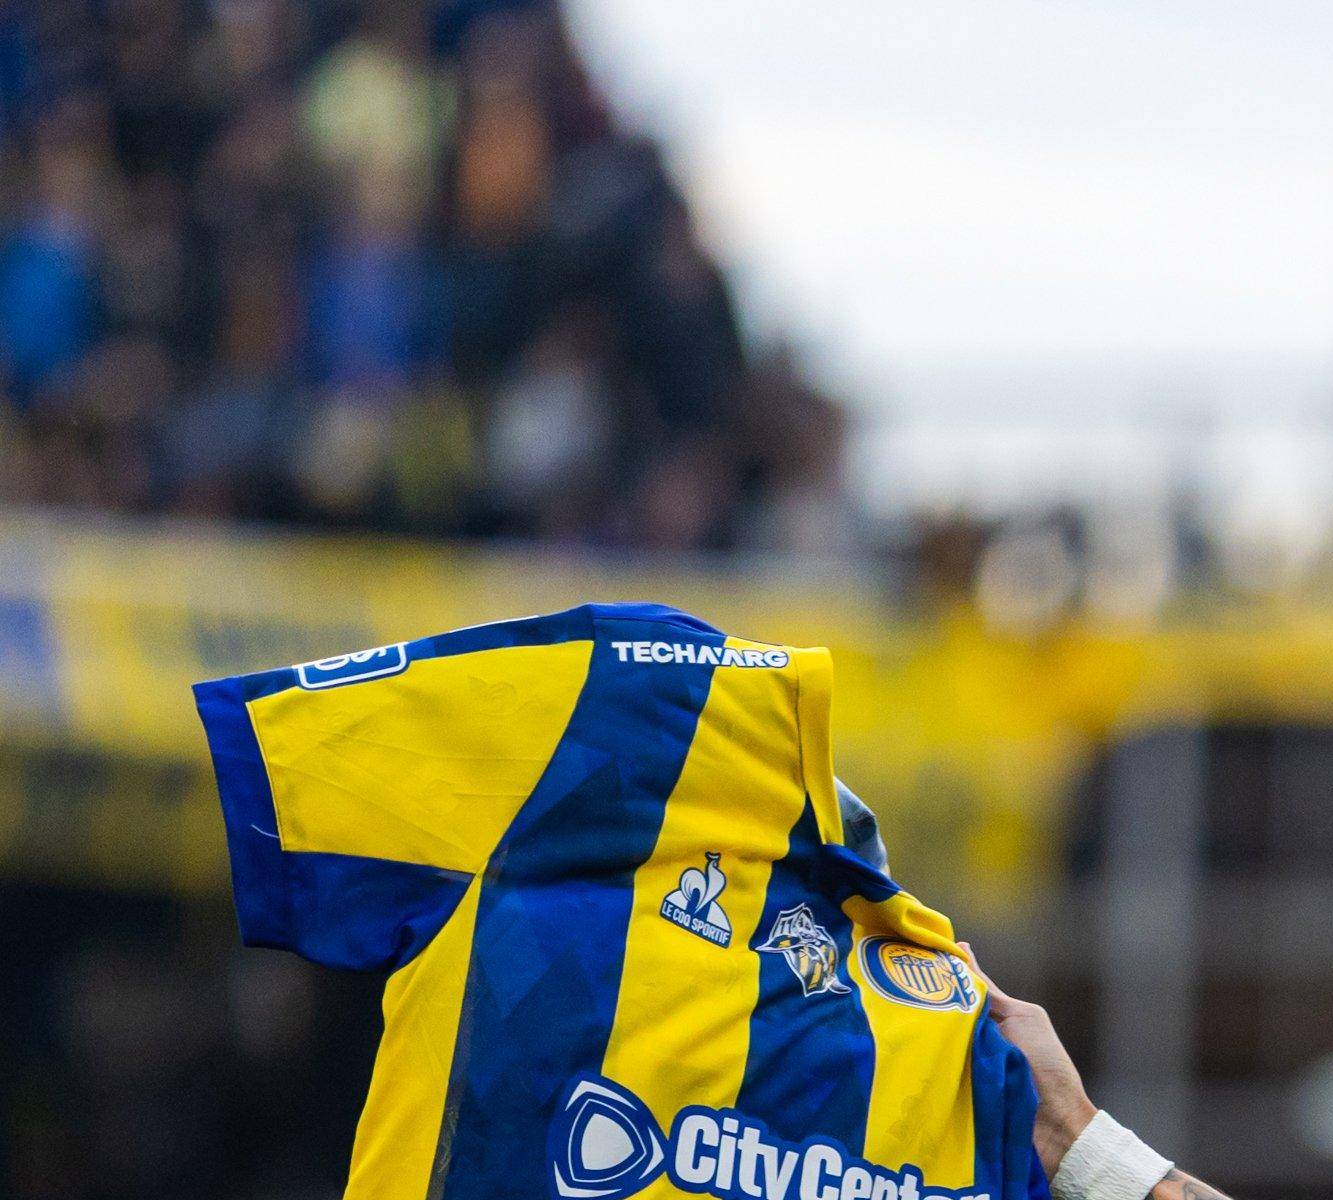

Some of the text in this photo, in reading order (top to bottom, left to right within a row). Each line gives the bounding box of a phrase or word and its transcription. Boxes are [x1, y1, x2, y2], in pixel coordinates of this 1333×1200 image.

[661, 901, 730, 944] LE COQ SPORTIF
